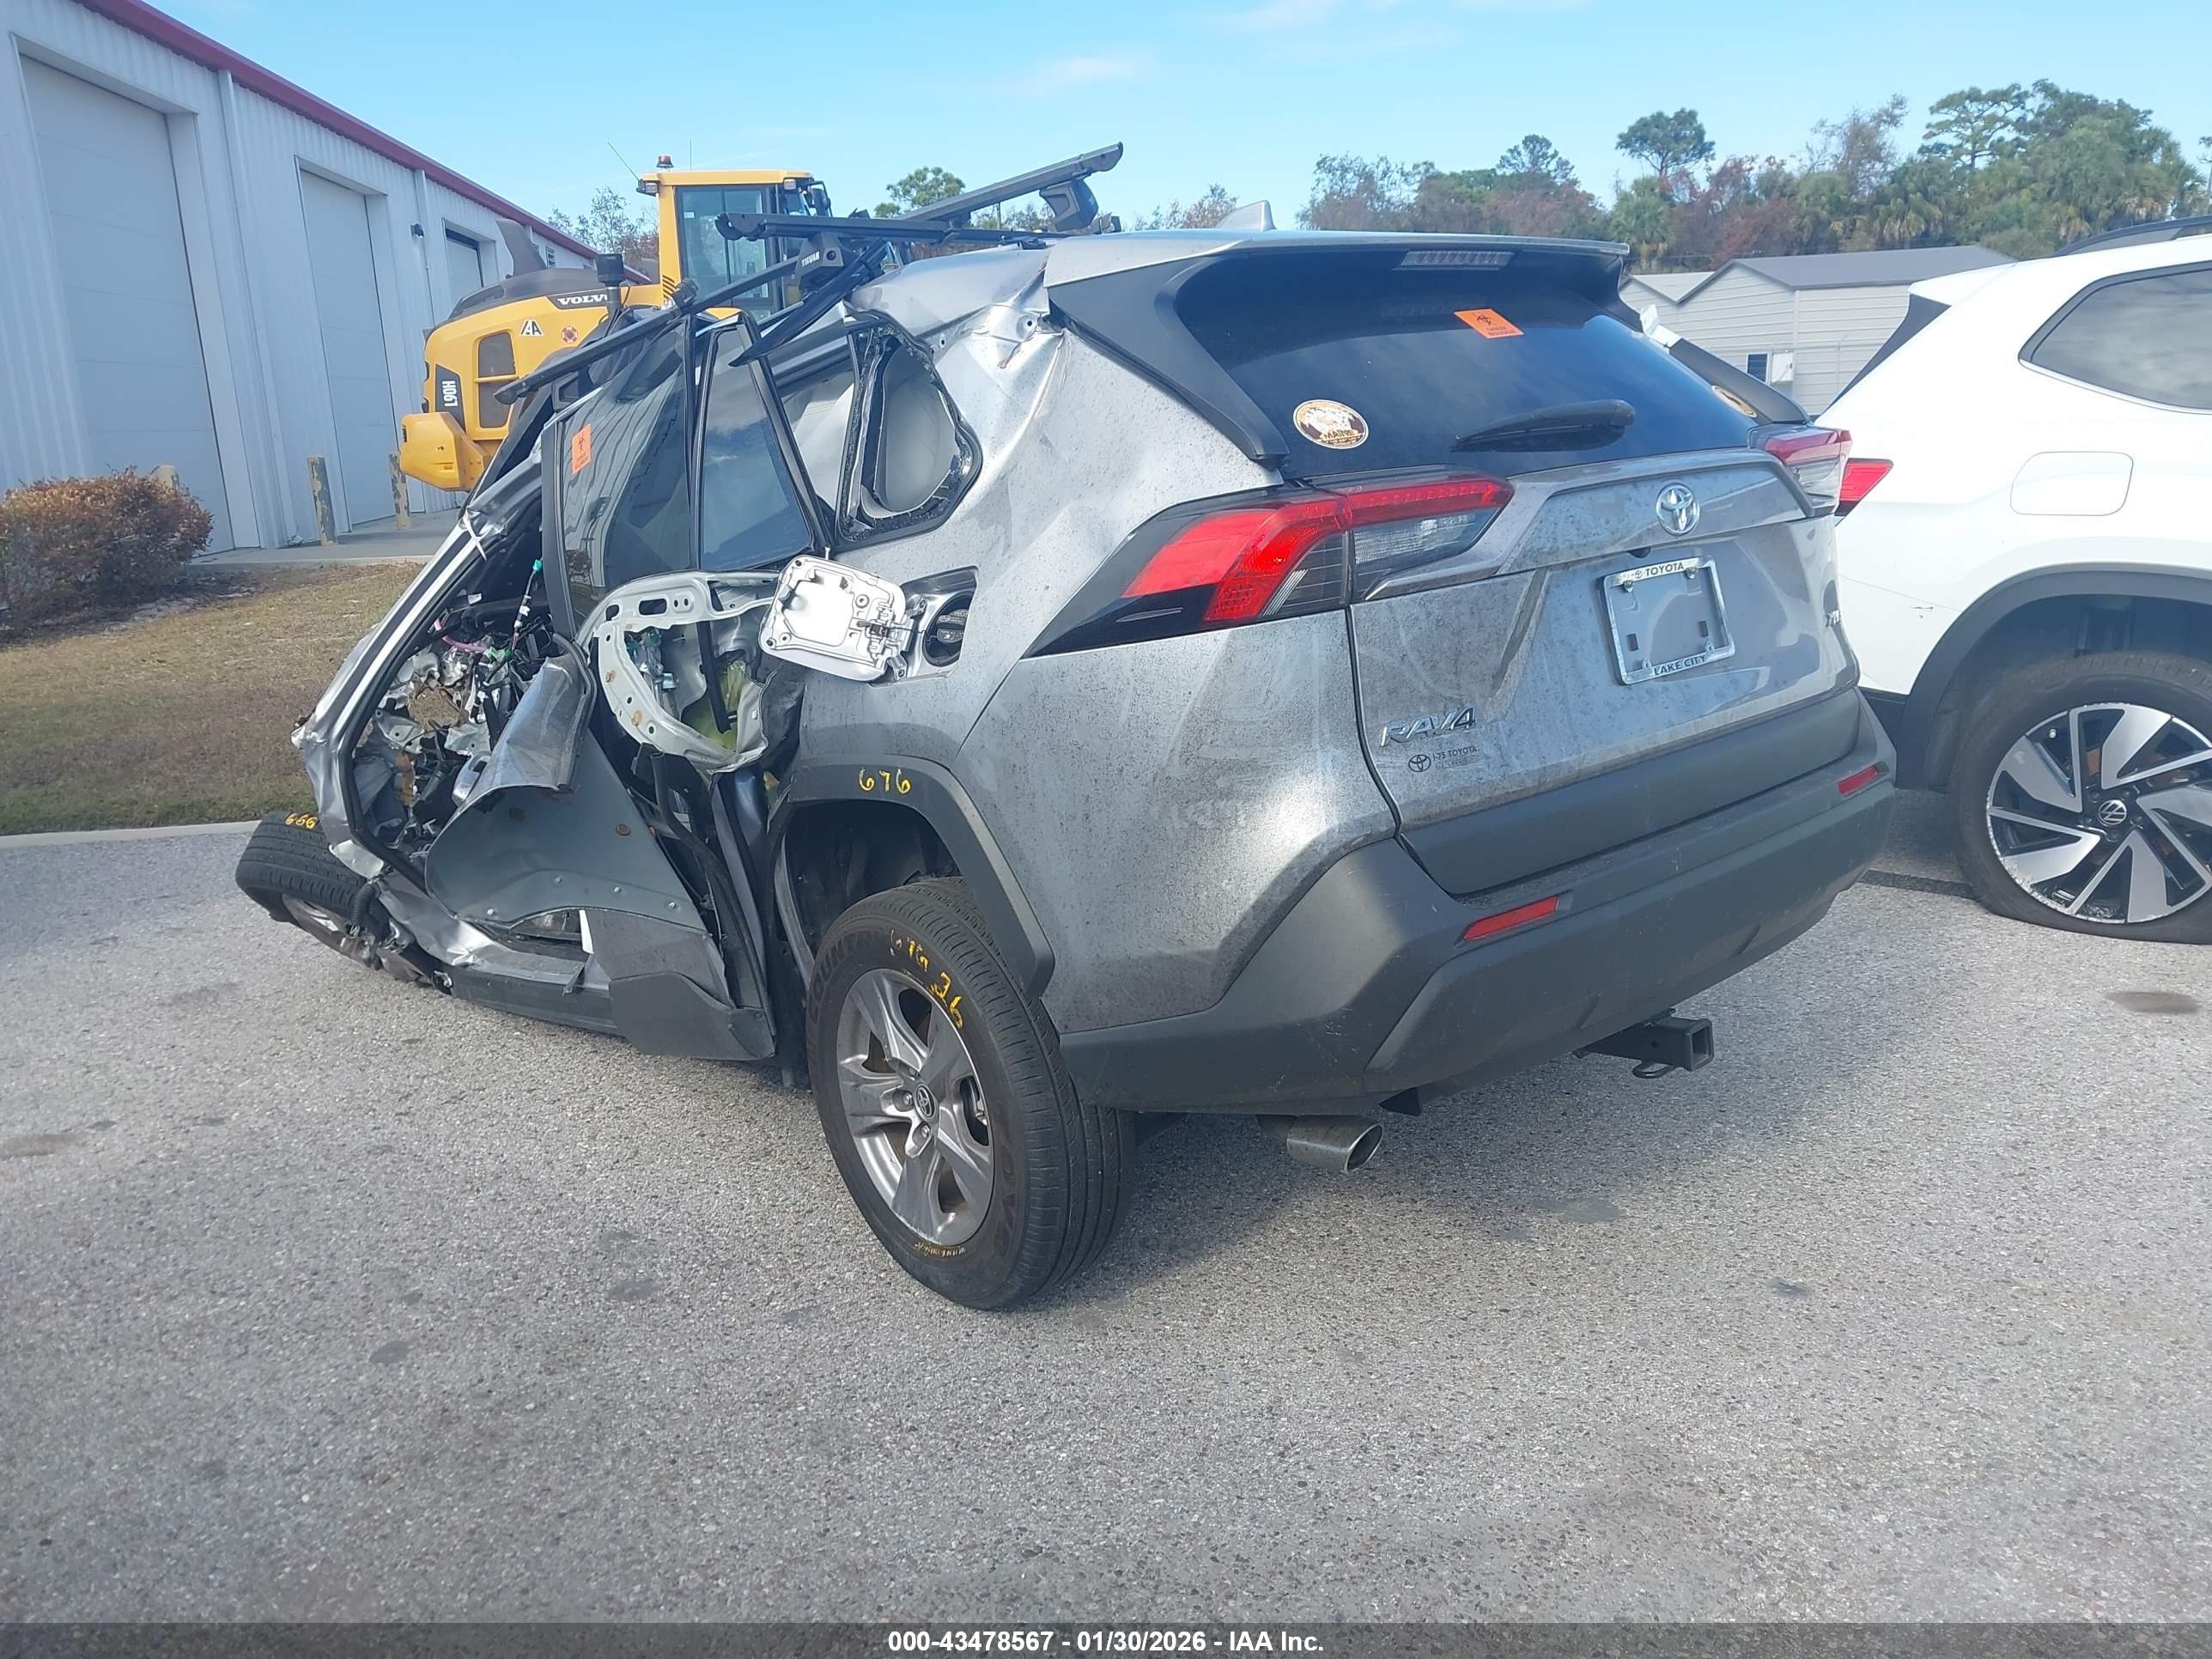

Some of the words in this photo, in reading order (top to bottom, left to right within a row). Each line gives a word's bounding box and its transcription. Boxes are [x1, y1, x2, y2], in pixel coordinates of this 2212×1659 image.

[441, 380, 459, 407] L90H
[1323, 429, 1355, 440] MAINE
[1645, 562, 1685, 577] TOYOTA
[1654, 662, 1682, 676] LAKE
[1684, 654, 1706, 668] CITY
[1380, 707, 1476, 746] RAV4
[1449, 745, 1478, 757] TOYOTA
[859, 766, 911, 794] 676
[285, 812, 318, 830] 666
